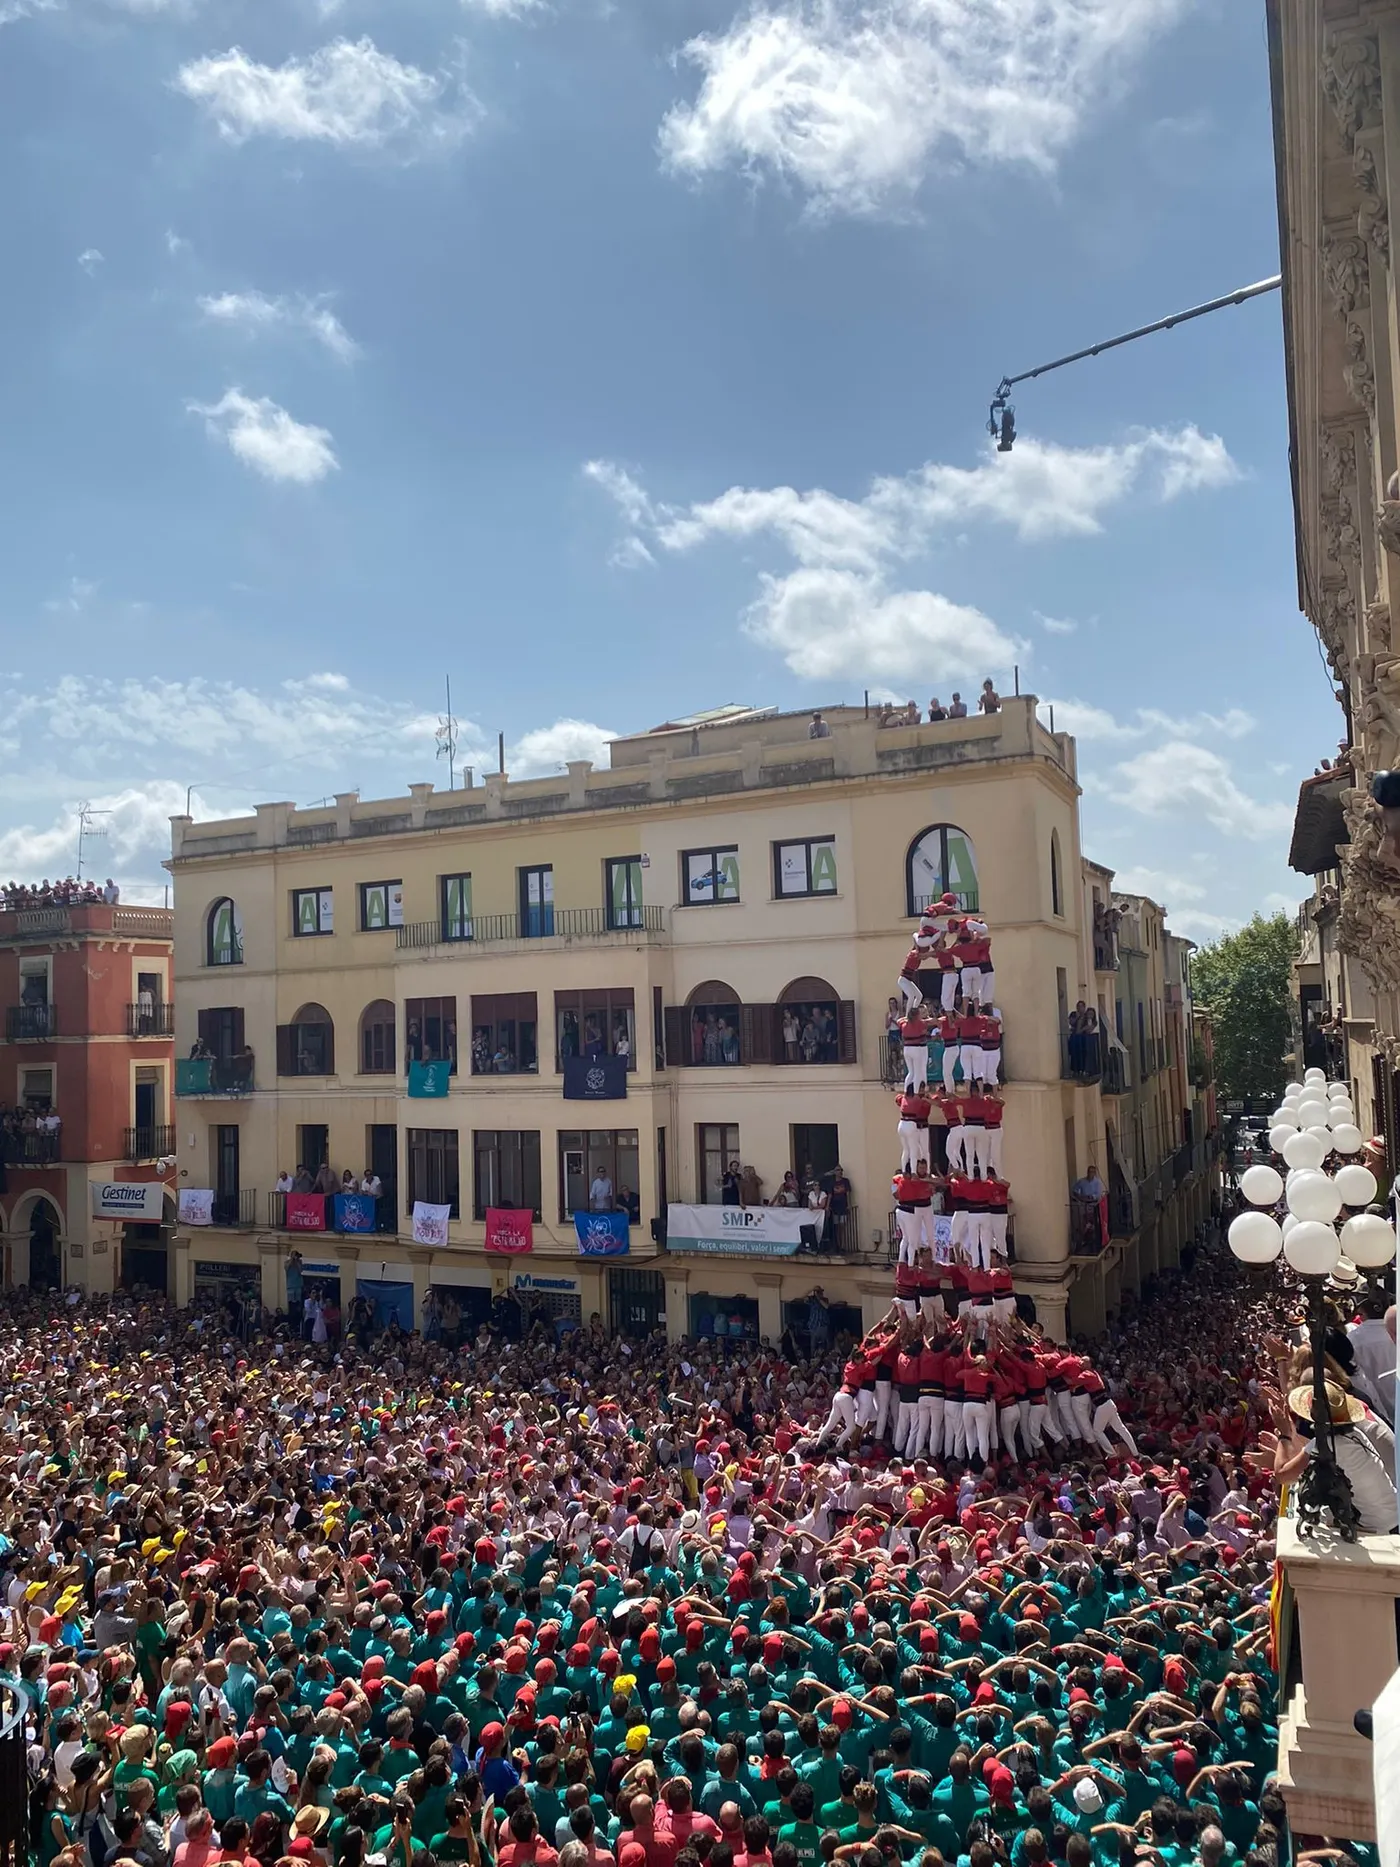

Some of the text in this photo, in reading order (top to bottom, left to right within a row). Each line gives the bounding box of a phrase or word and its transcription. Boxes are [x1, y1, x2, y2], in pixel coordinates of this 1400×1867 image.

[718, 857, 739, 898] A
[812, 846, 837, 890] A
[366, 890, 386, 928] A
[449, 879, 472, 937] A
[613, 863, 643, 925] A
[300, 896, 317, 933] A
[101, 1185, 146, 1201] Gestinet
[722, 1212, 753, 1226] SMP
[697, 1240, 719, 1251] Força,
[719, 1241, 750, 1252] equilibri,
[751, 1243, 768, 1252] valor
